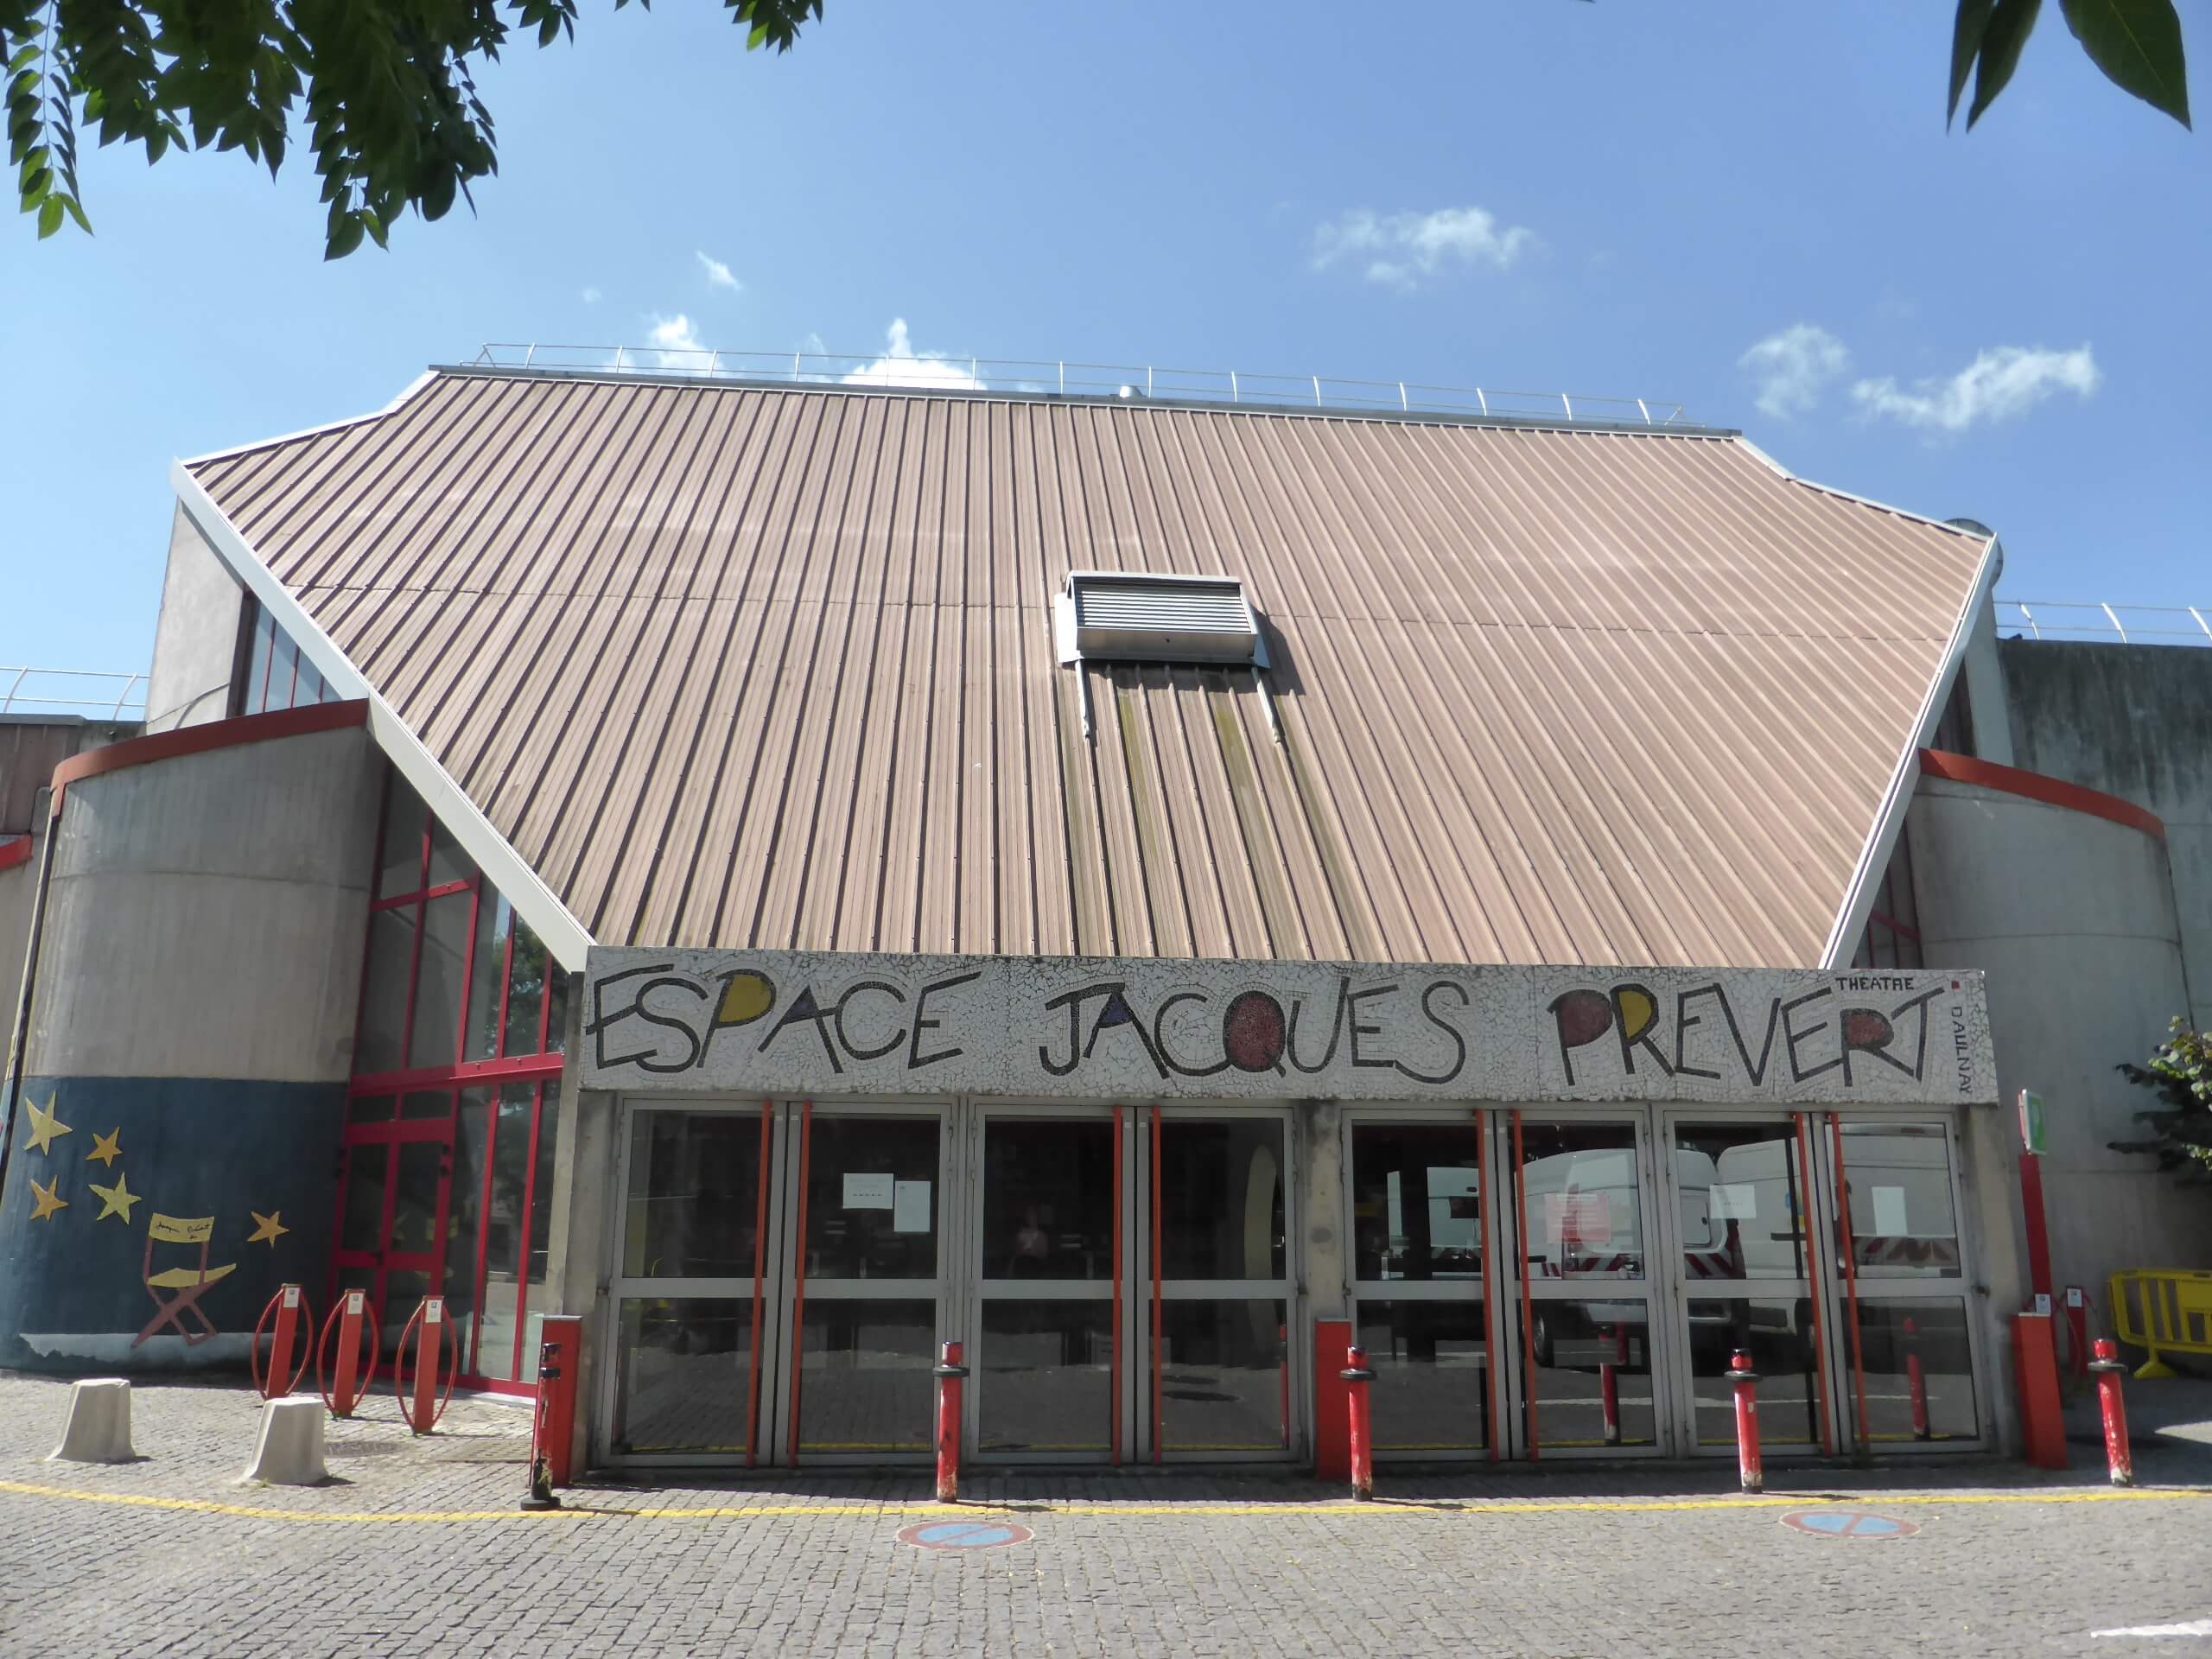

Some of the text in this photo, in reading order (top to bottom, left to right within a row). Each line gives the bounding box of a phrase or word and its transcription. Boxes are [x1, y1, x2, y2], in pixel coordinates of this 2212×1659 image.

[1835, 977, 1915, 991] THEATRE
[586, 963, 1945, 1087] ESPACE JACQUES PREVERT
